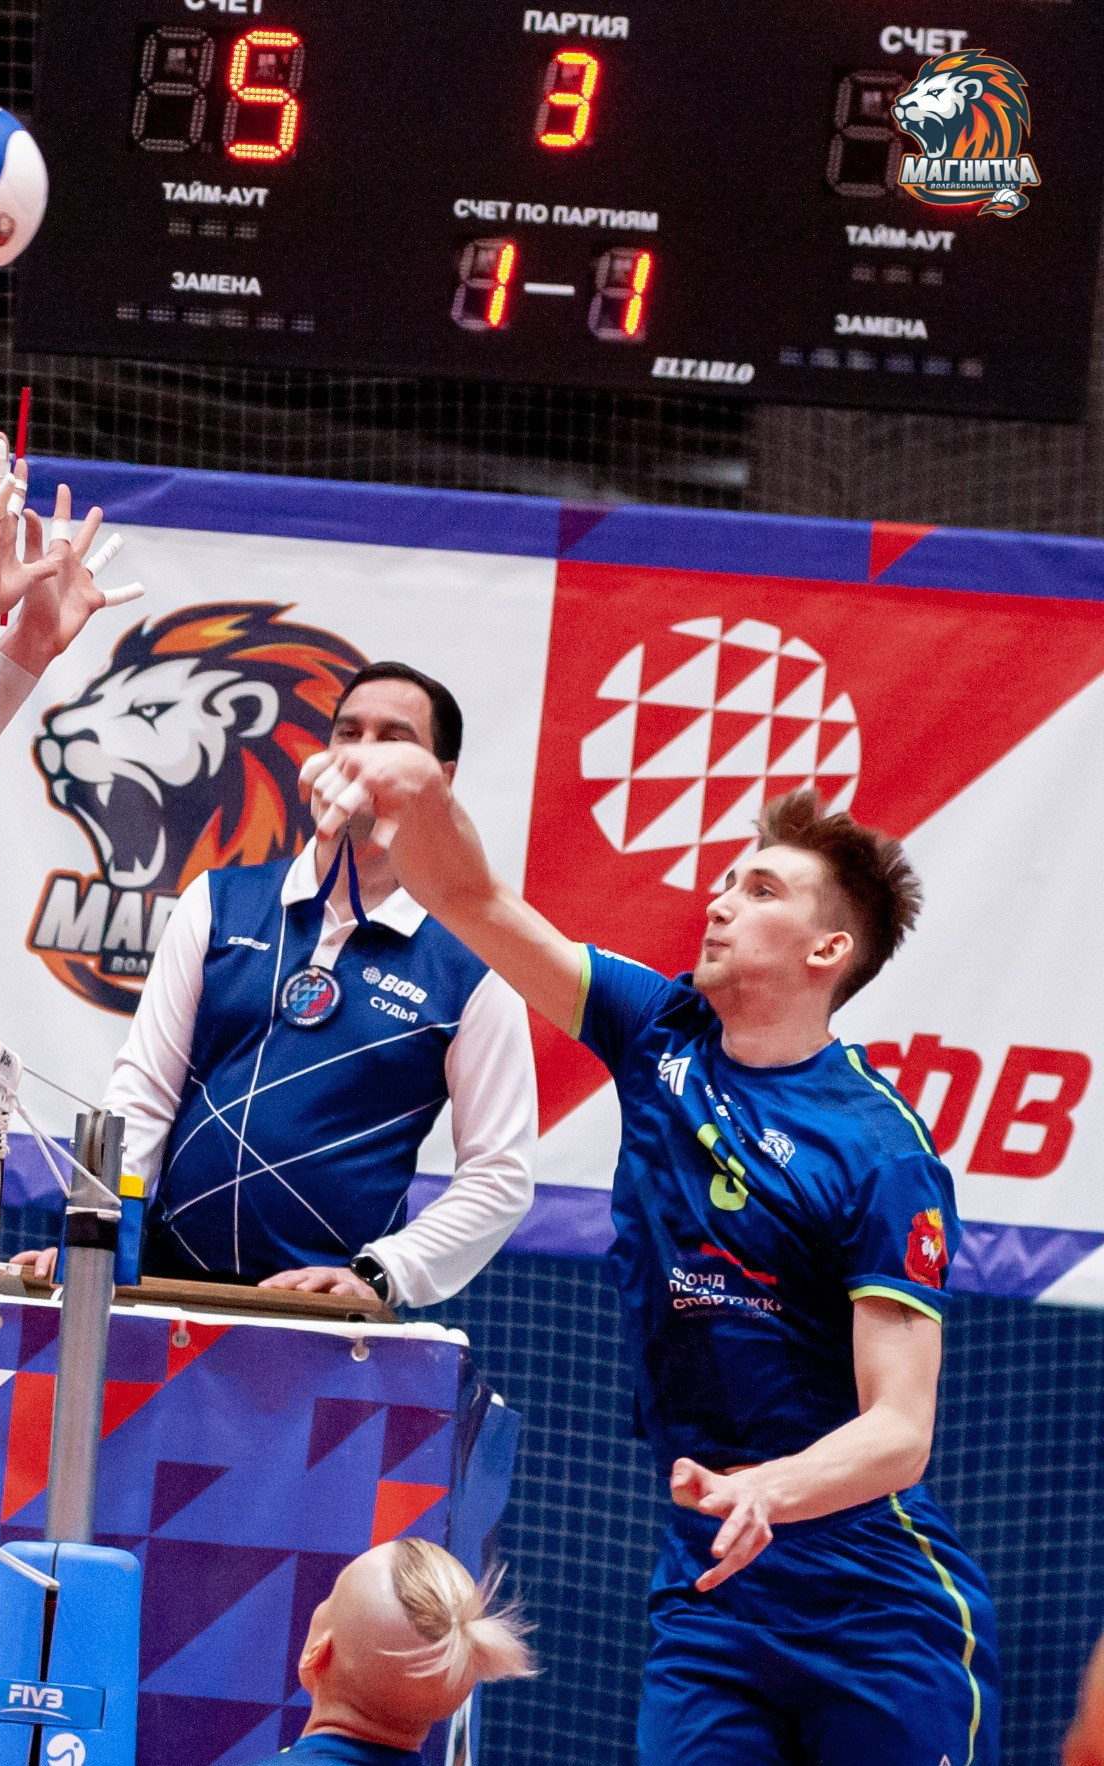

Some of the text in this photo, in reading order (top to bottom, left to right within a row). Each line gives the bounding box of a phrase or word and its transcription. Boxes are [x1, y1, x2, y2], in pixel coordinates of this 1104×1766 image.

[523, 9, 630, 40] ПАРТИЯ
[879, 25, 968, 56] СЧЕТ
[228, 30, 299, 160] 5
[539, 51, 599, 148] 3
[162, 181, 270, 208] ТАЙМ-АУТ
[453, 198, 659, 232] СЧЕТ ПО ПАРТИЯМ
[844, 223, 956, 253] ТАЙМ-АУТ
[170, 271, 263, 297] ЗАМЕНА
[834, 313, 929, 341] ЗАМЕНА
[378, 973, 428, 1005] ВФВ
[370, 995, 419, 1024] СУДЬЯ
[671, 1266, 727, 1291] ФОНД
